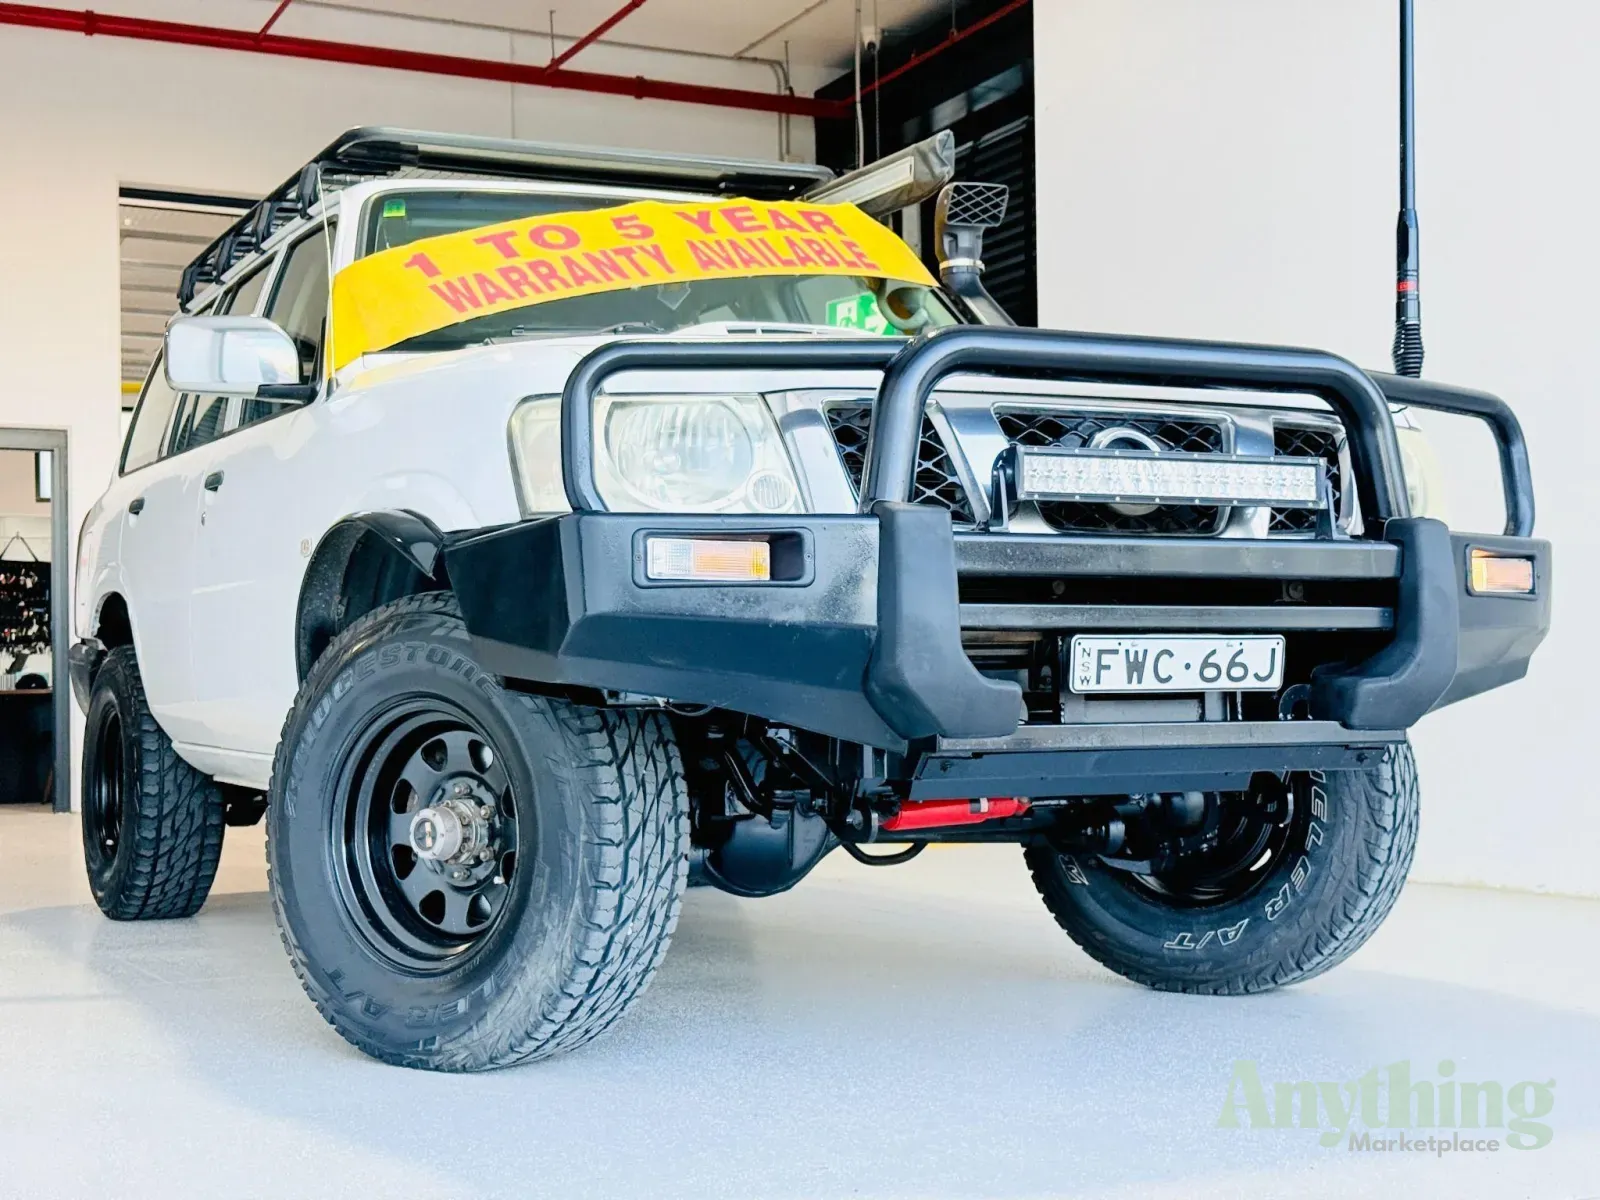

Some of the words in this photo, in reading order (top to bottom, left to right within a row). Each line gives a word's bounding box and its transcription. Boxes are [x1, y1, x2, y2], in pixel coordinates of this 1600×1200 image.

[404, 252, 442, 279] 1
[474, 224, 581, 260] TO
[611, 215, 654, 239] 5
[677, 206, 845, 235] YEAR
[428, 244, 674, 313] WARRANTY
[687, 237, 879, 270] AVAILABLE
[1079, 647, 1092, 686] NSW
[1163, 917, 1250, 951] A/T
